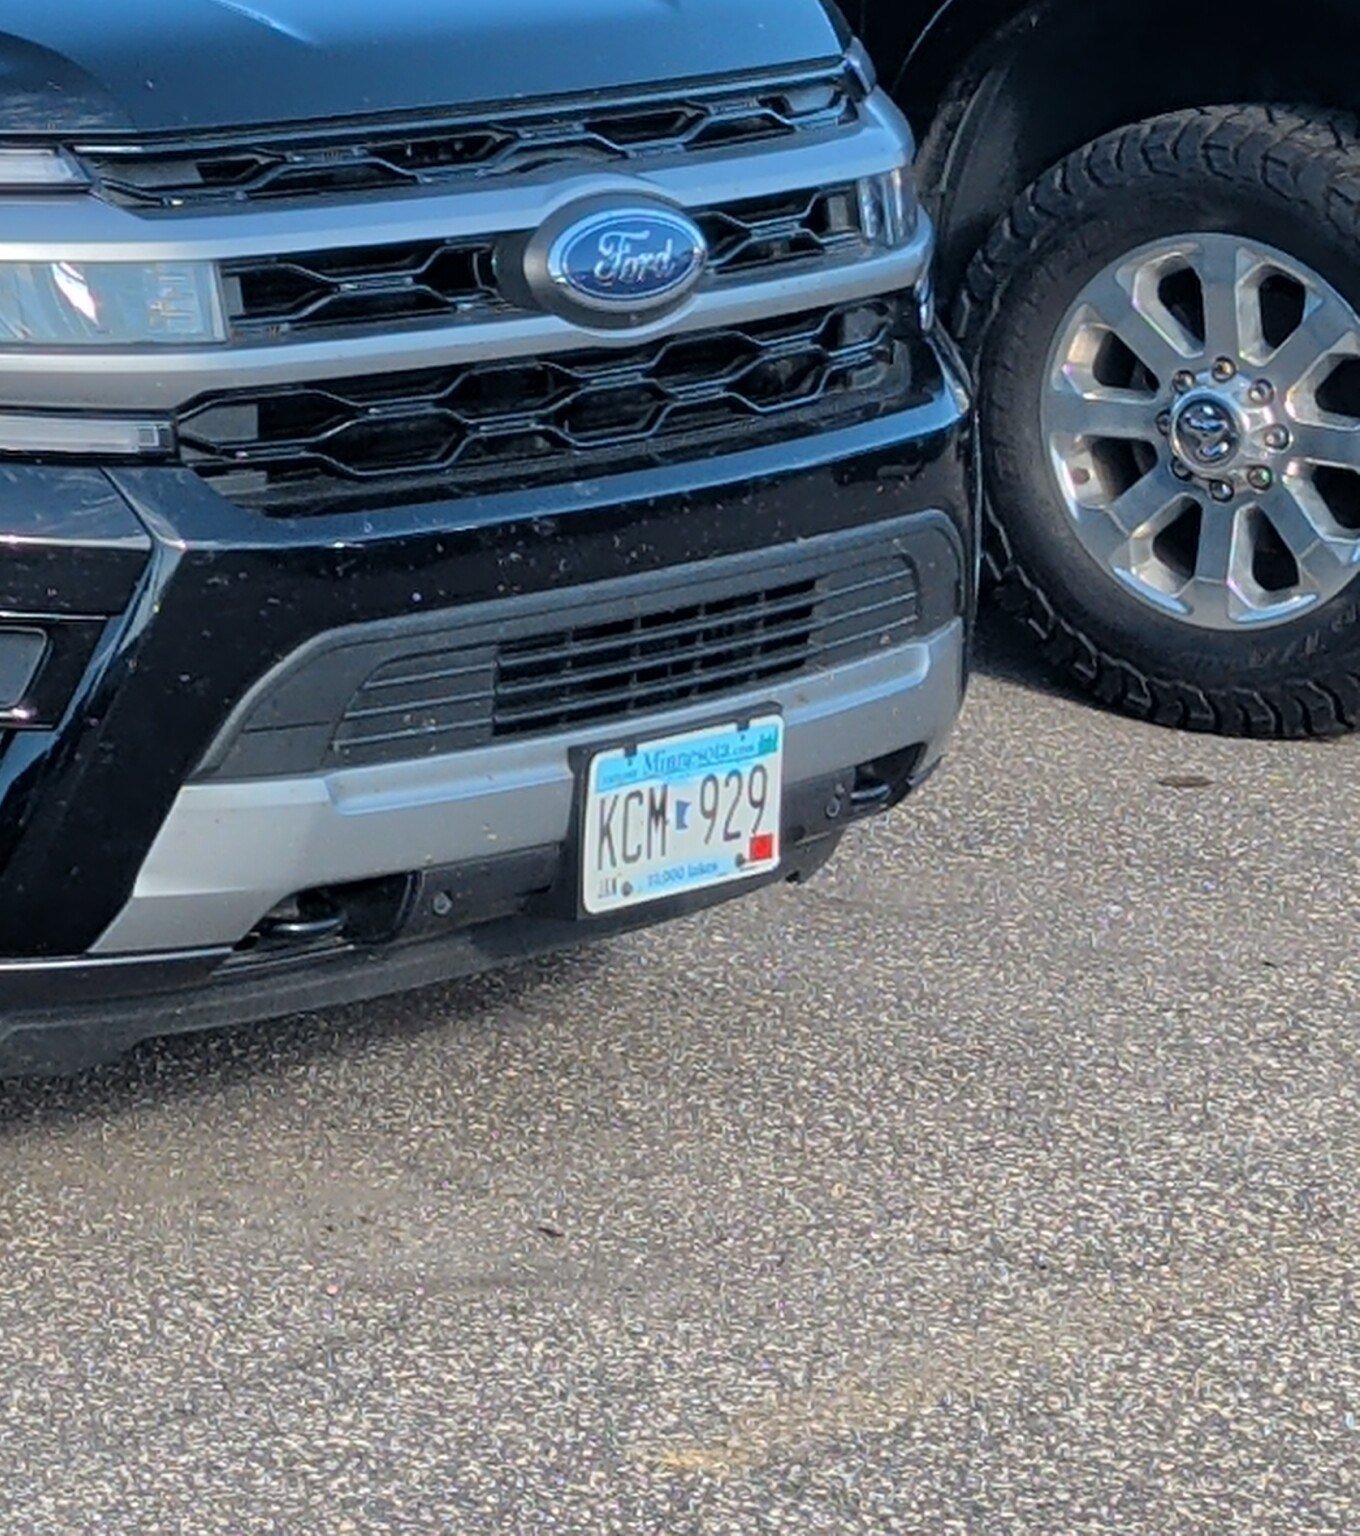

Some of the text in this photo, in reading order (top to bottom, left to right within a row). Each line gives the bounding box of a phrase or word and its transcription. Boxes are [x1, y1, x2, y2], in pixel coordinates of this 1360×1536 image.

[593, 229, 677, 288] Ford
[597, 763, 769, 871] KCM 929
